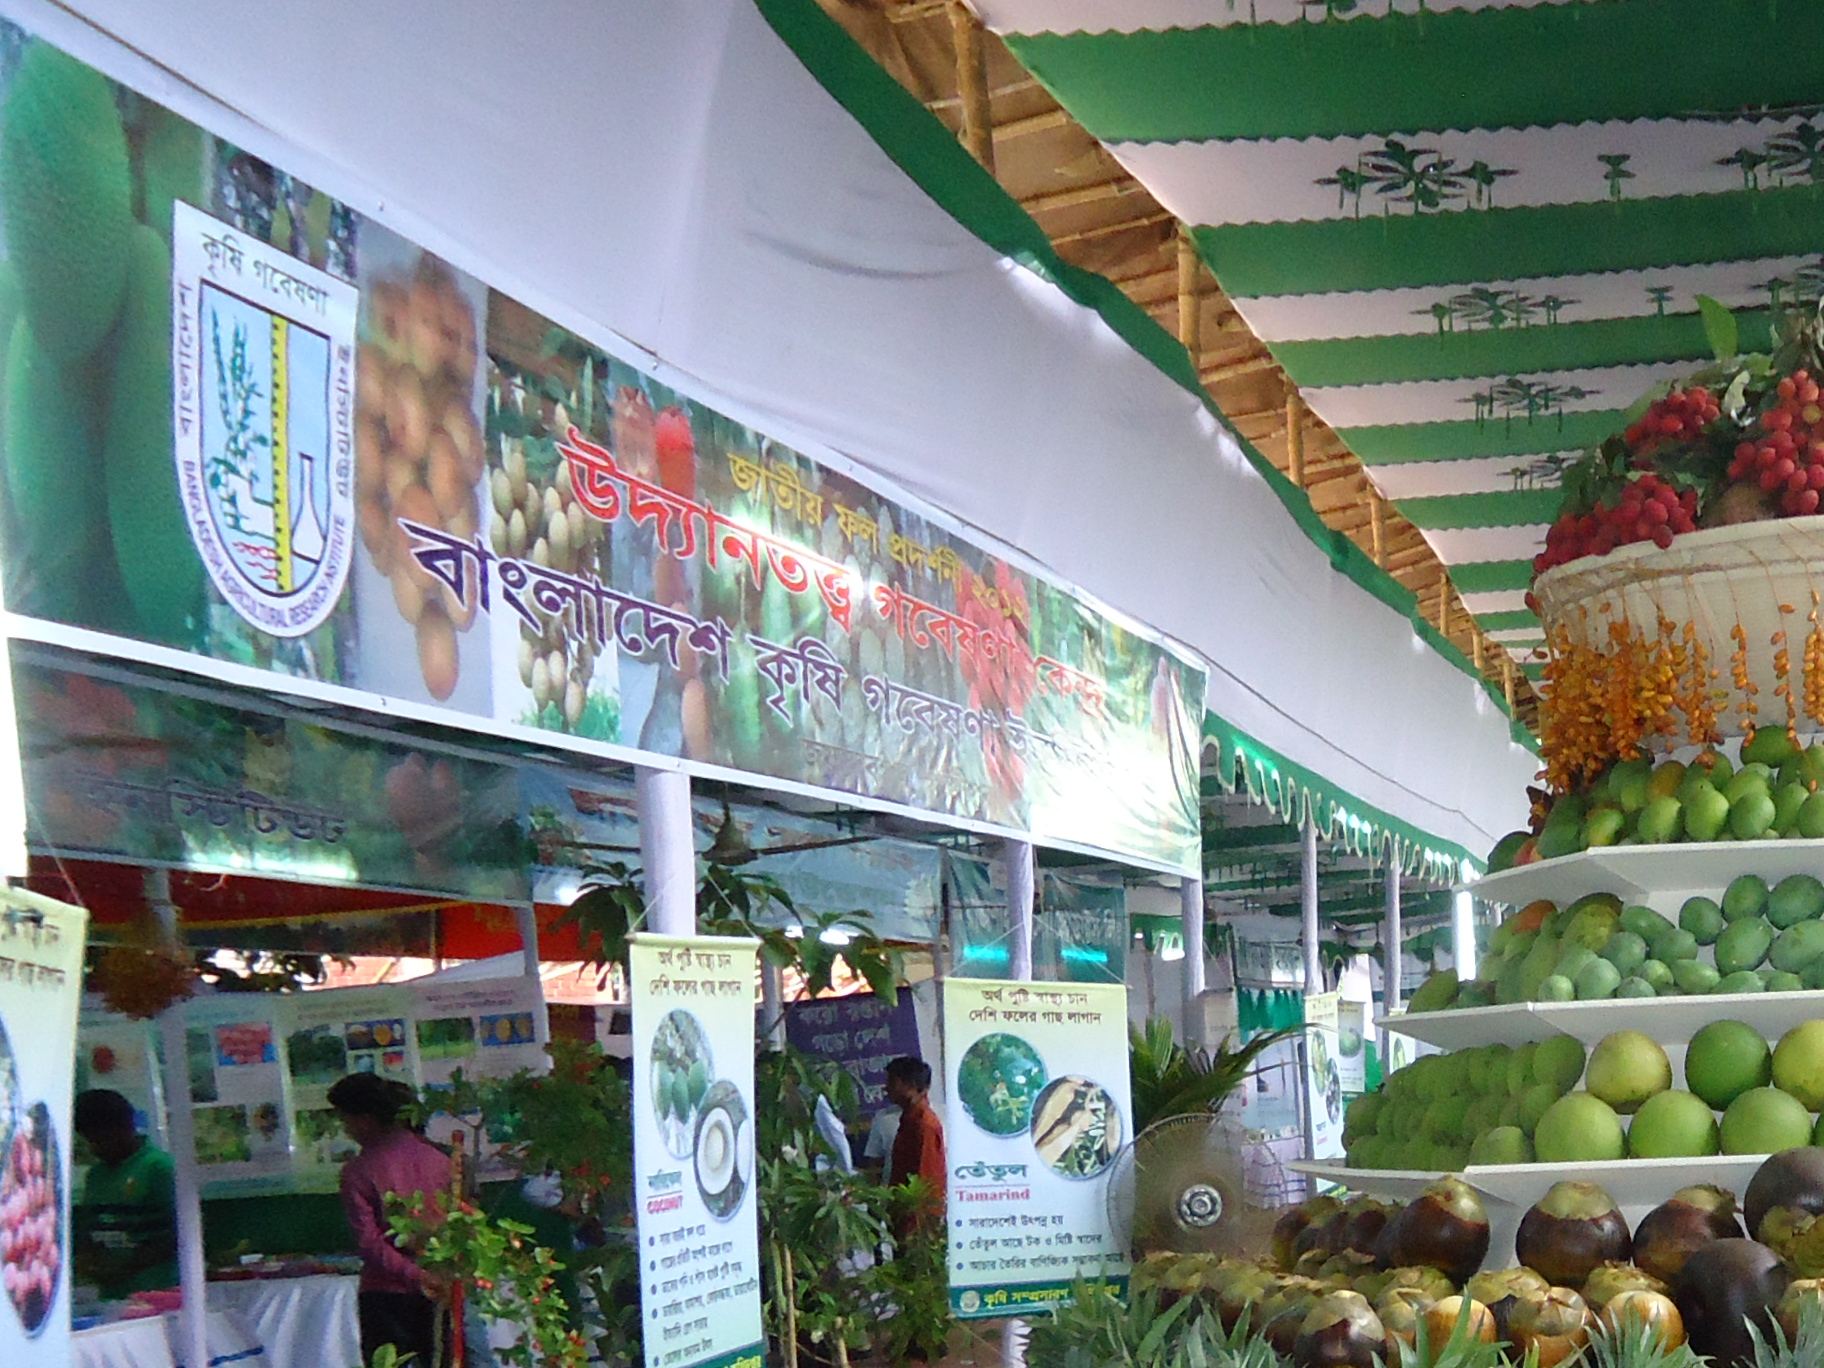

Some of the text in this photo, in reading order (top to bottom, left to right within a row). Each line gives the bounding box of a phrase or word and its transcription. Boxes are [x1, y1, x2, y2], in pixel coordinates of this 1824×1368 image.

[200, 233, 330, 316] কৃষি গবেষণা
[727, 452, 823, 528] জাতীয়
[833, 502, 878, 555] ফল
[399, 517, 1003, 746] বাংলাদেশ কৃষি গবেষণা
[873, 581, 1022, 672] গবেষণা
[981, 988, 1003, 1003] অর্থ
[1008, 987, 1031, 1006] পুষ্টি
[1067, 992, 1089, 1006] চান
[968, 1005, 1103, 1025] দেশি ফলের গাছ লাগান
[954, 1160, 1029, 1183] তেঁতুল
[955, 1187, 1032, 1203] Tamarind
[1025, 1235, 1041, 1247] টক
[983, 1288, 1008, 1310] কৃষি
